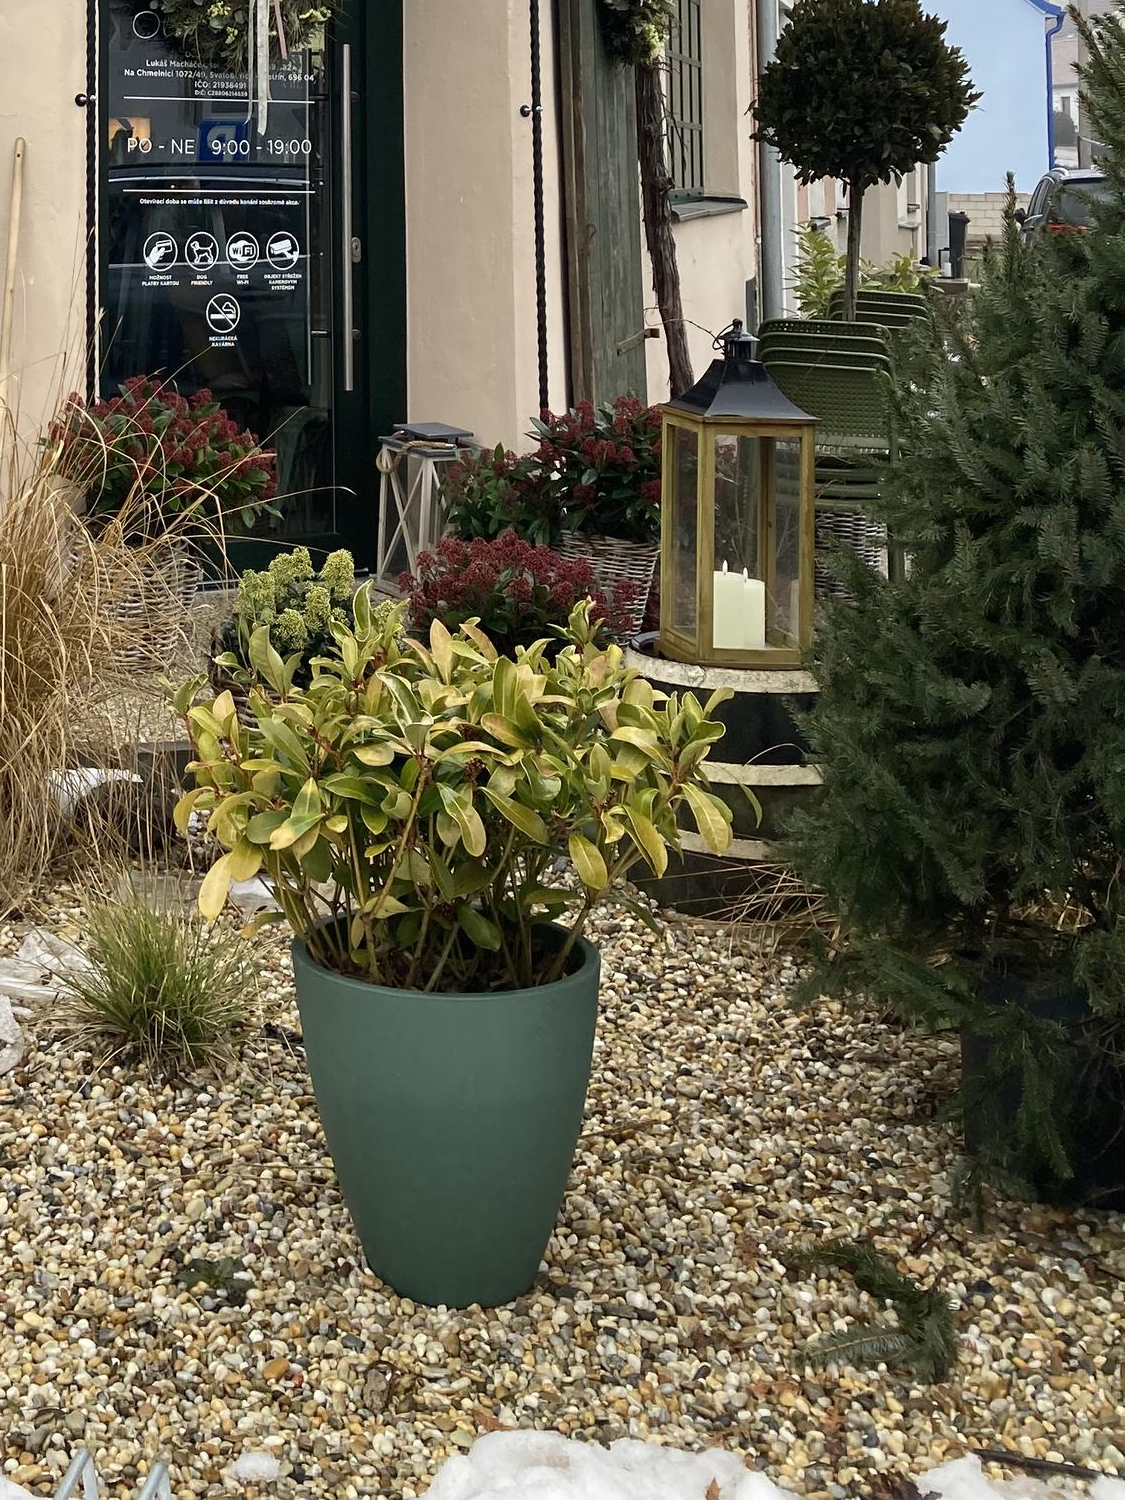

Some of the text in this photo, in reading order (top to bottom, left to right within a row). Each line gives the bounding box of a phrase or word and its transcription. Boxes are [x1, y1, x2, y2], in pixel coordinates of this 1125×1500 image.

[146, 59, 168, 67] Lukáš
[194, 80, 211, 88] IČO:
[127, 138, 153, 154] PO
[171, 139, 196, 155] NE
[211, 139, 250, 156] 9:00
[267, 139, 312, 155] 19:00
